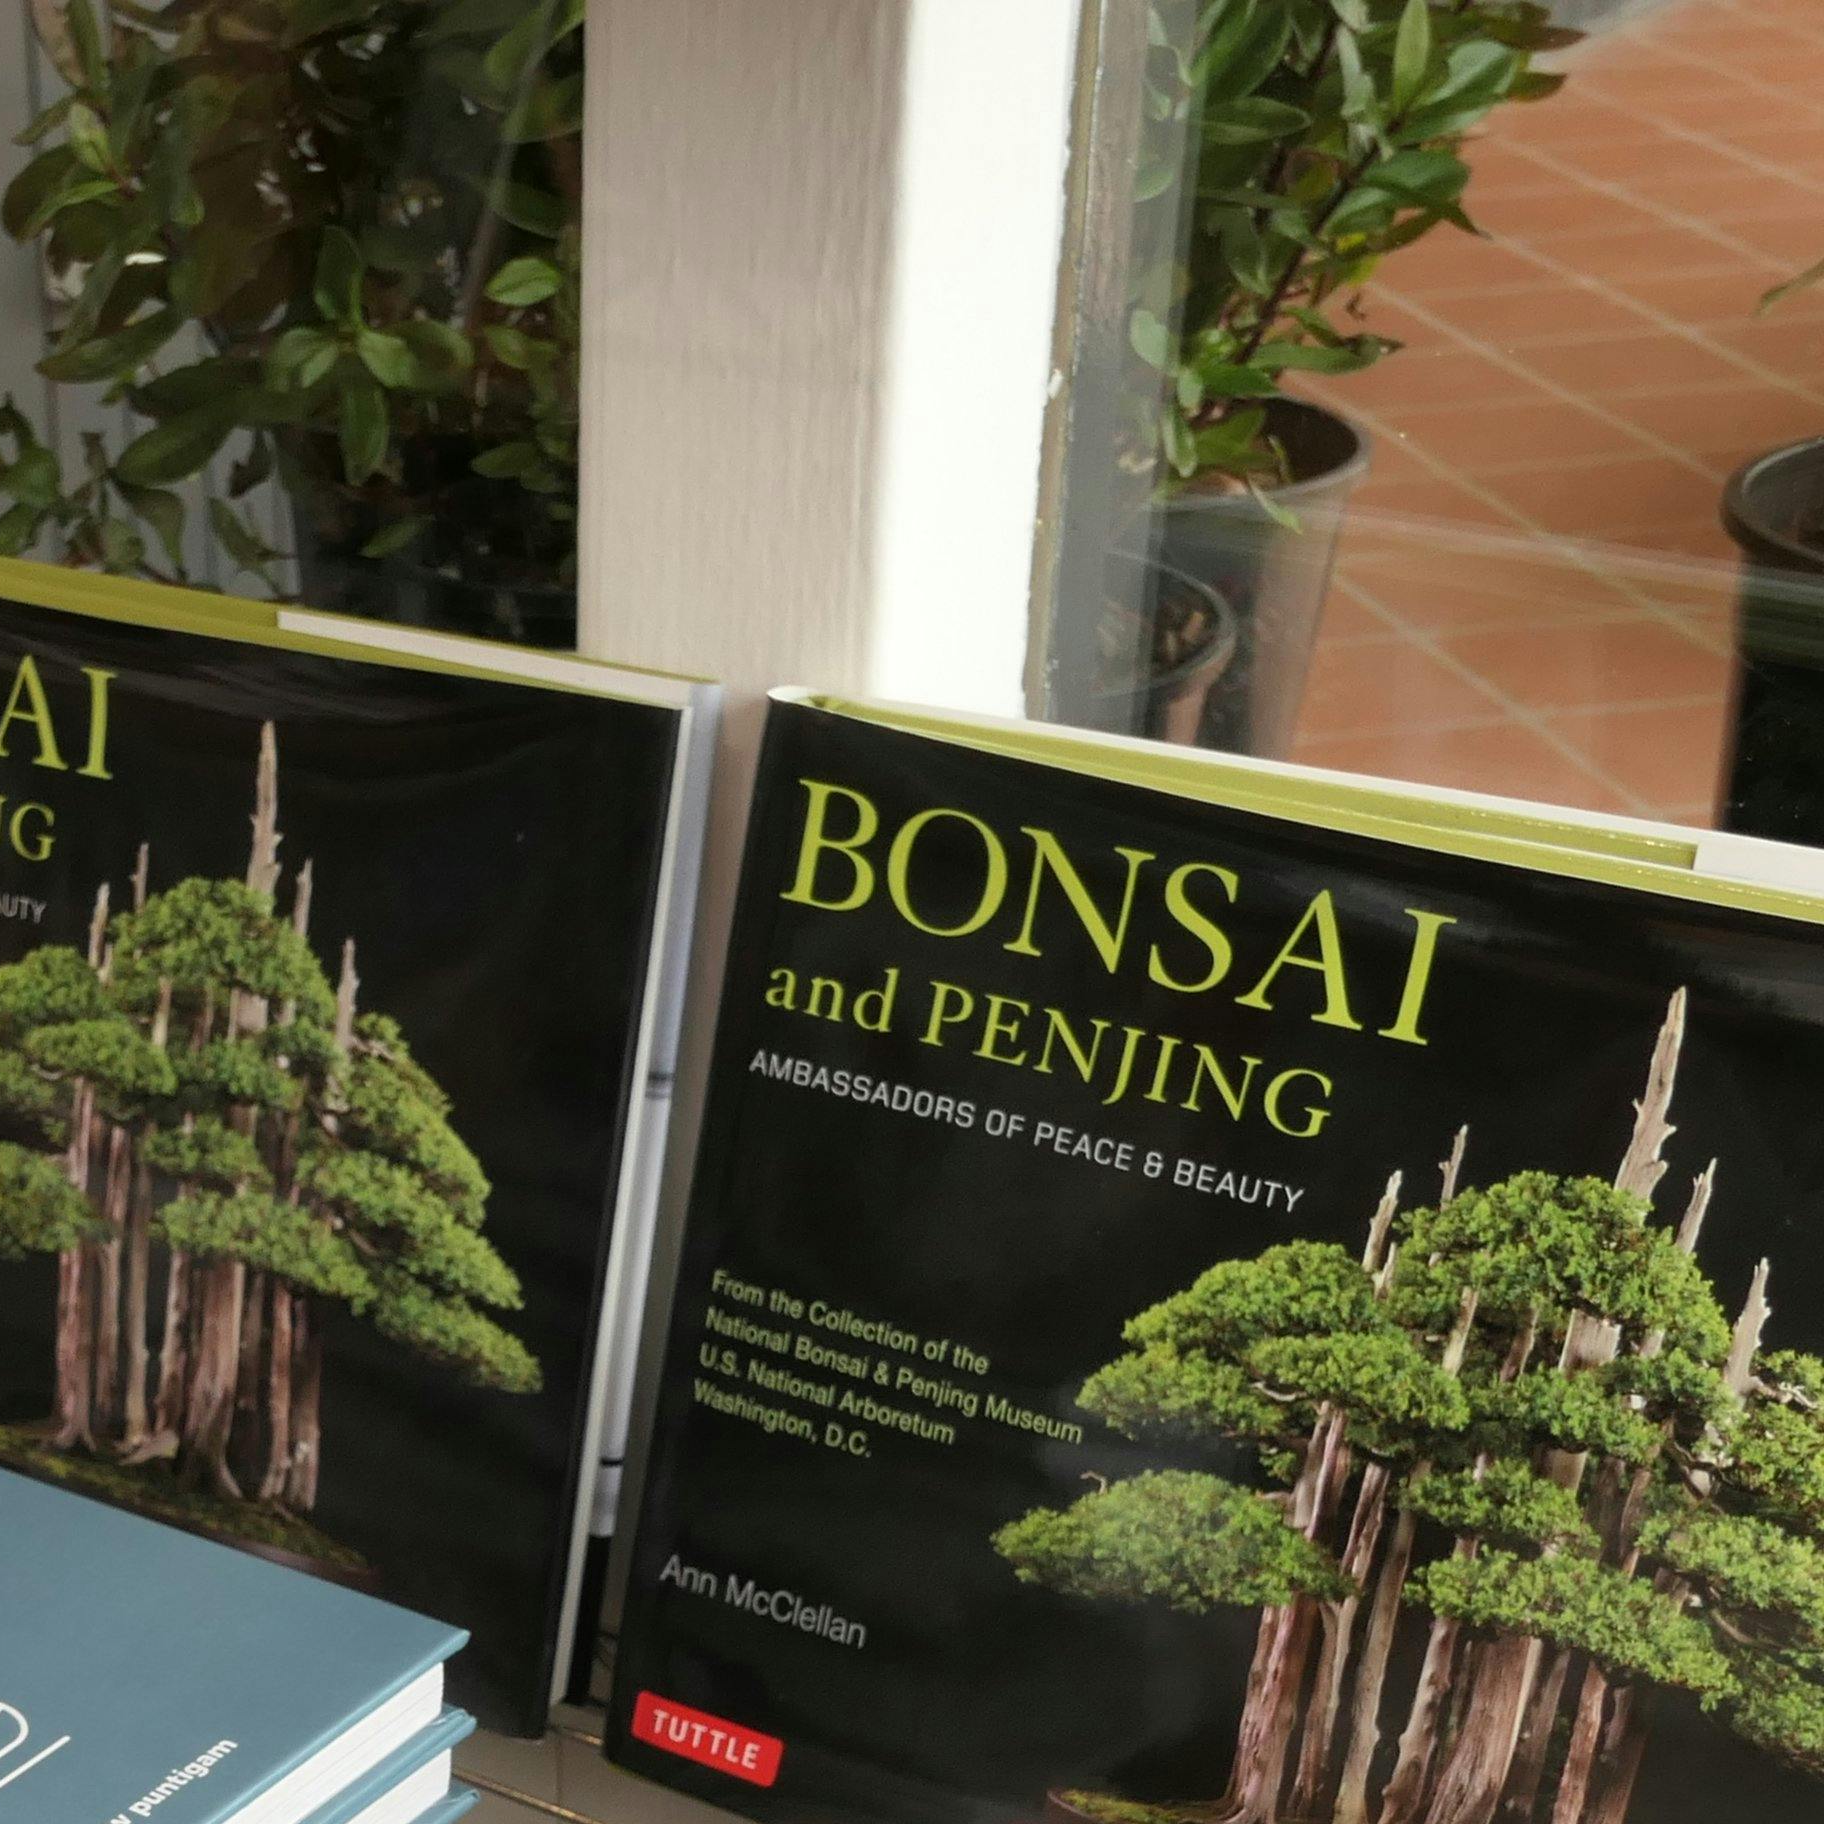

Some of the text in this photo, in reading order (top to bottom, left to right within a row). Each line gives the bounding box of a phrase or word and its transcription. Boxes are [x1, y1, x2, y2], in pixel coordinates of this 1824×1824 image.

[779, 778, 1458, 1046] BONSAI
[765, 967, 1334, 1139] and PENJING
[749, 1049, 1306, 1213] AMBASSADORS OF PEACE & BEAUTY
[712, 1269, 990, 1376] From the Collection of the
[693, 1378, 873, 1459] Washington, D.C.
[700, 1343, 957, 1447] U.S. National Arboretum
[705, 1306, 1084, 1446] National Bonsai & Penjing Museum
[659, 1554, 868, 1650] Ann McClellan
[128, 1737, 239, 1820] puntigam
[652, 1708, 761, 1771] TUTTLE
